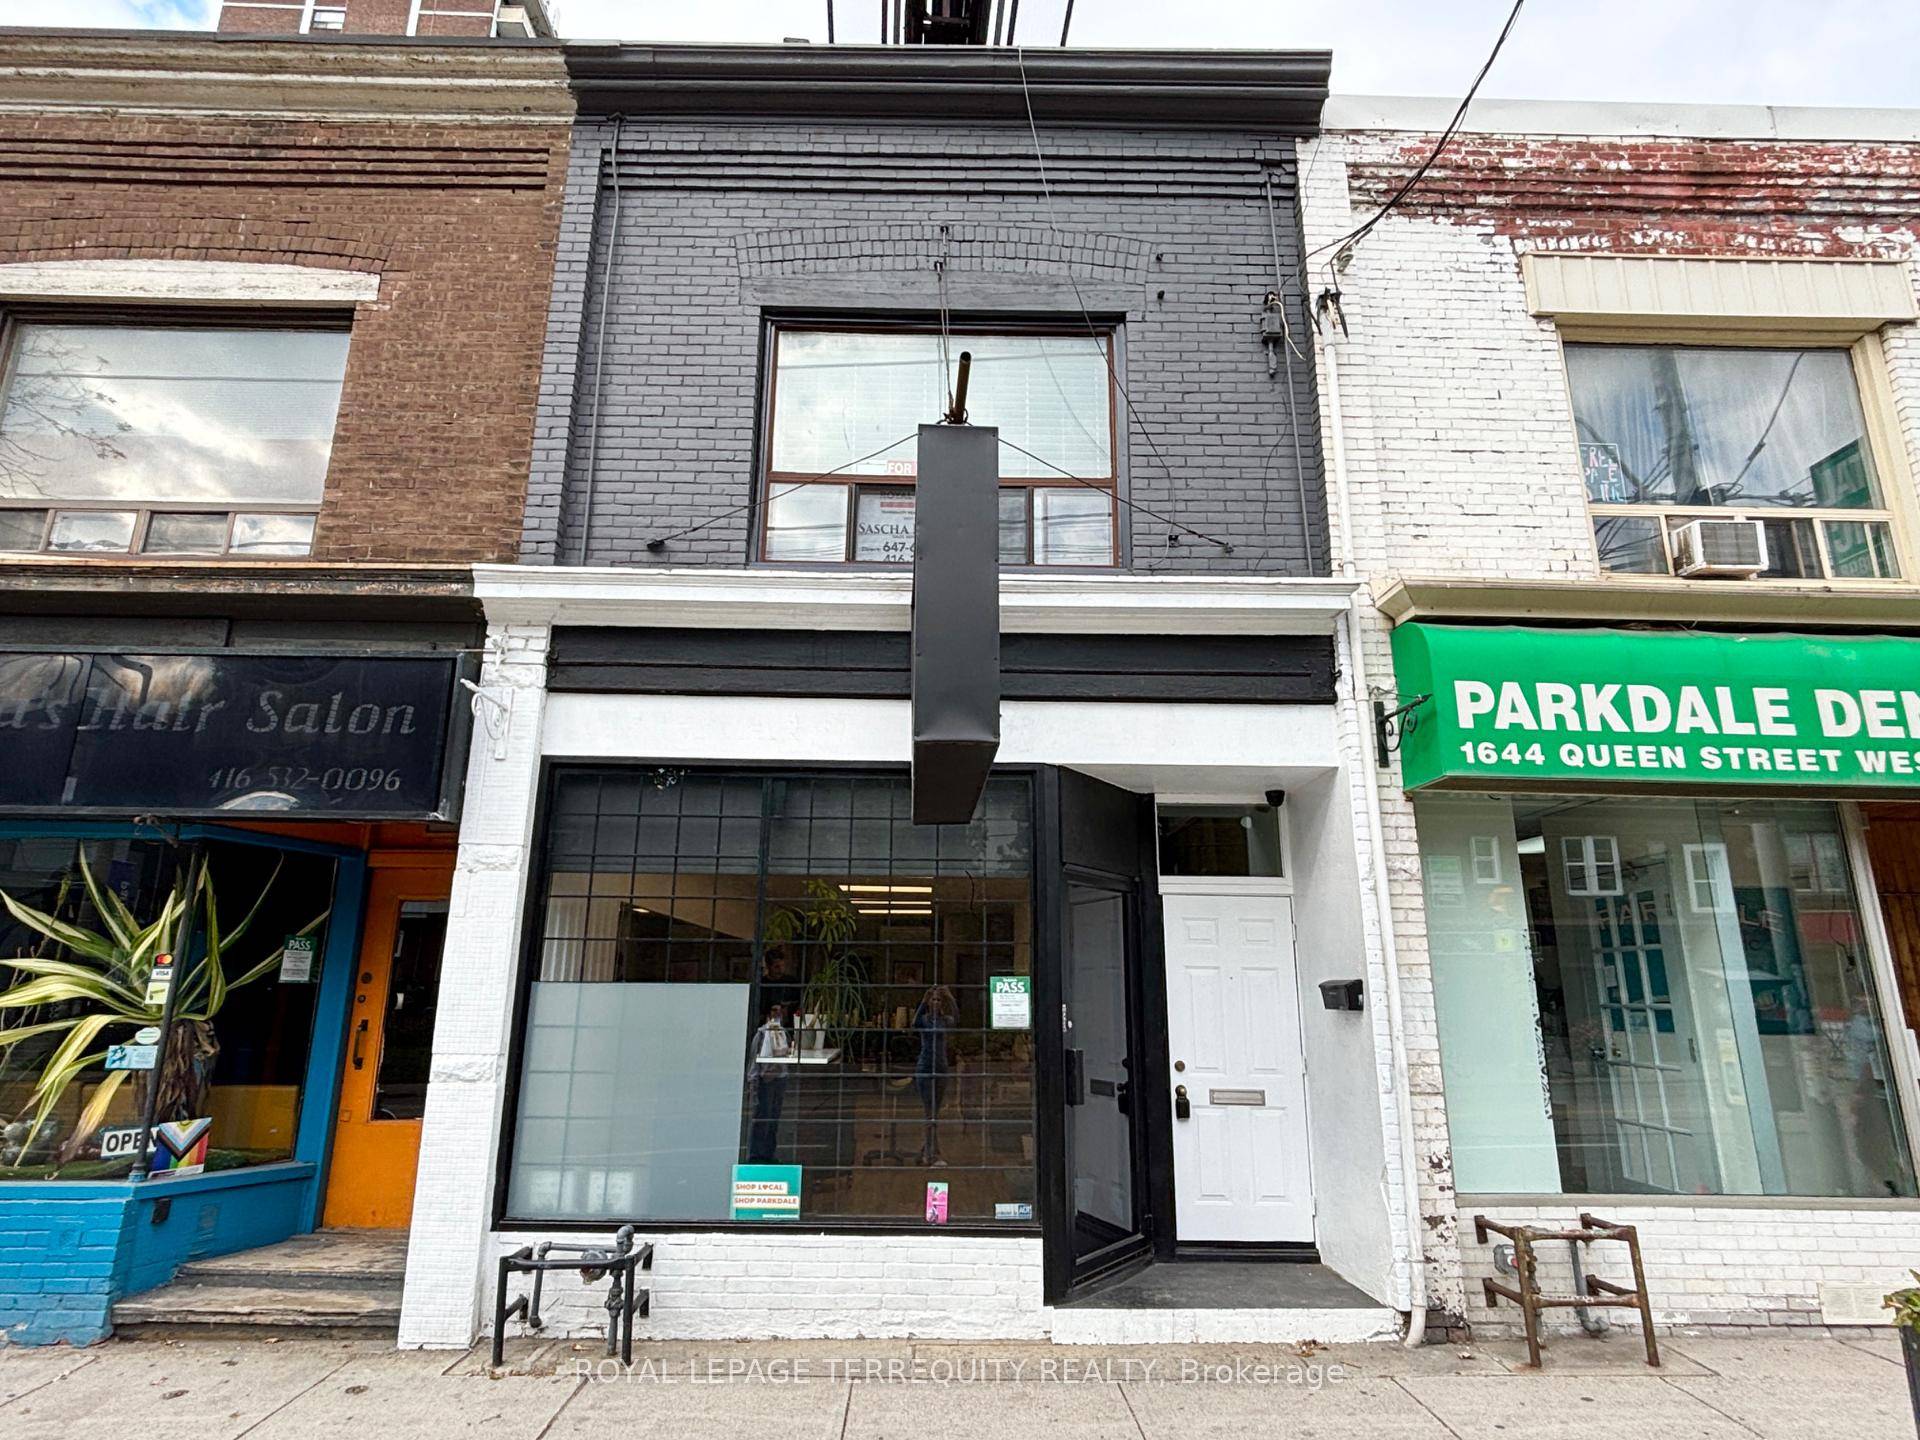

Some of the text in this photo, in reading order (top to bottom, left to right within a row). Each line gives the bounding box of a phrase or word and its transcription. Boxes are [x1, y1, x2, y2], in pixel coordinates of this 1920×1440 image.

[887, 463, 913, 474] FOR
[858, 522, 909, 535] SASCHA
[78, 686, 226, 732] Hair
[246, 690, 416, 734] Salon
[1454, 680, 1797, 736] PARKDALE
[1460, 741, 1920, 774] 1644 QUEEN STREET WE
[209, 767, 400, 791] 416 532-0096
[288, 939, 311, 951] PASS
[996, 981, 1025, 993] PASS
